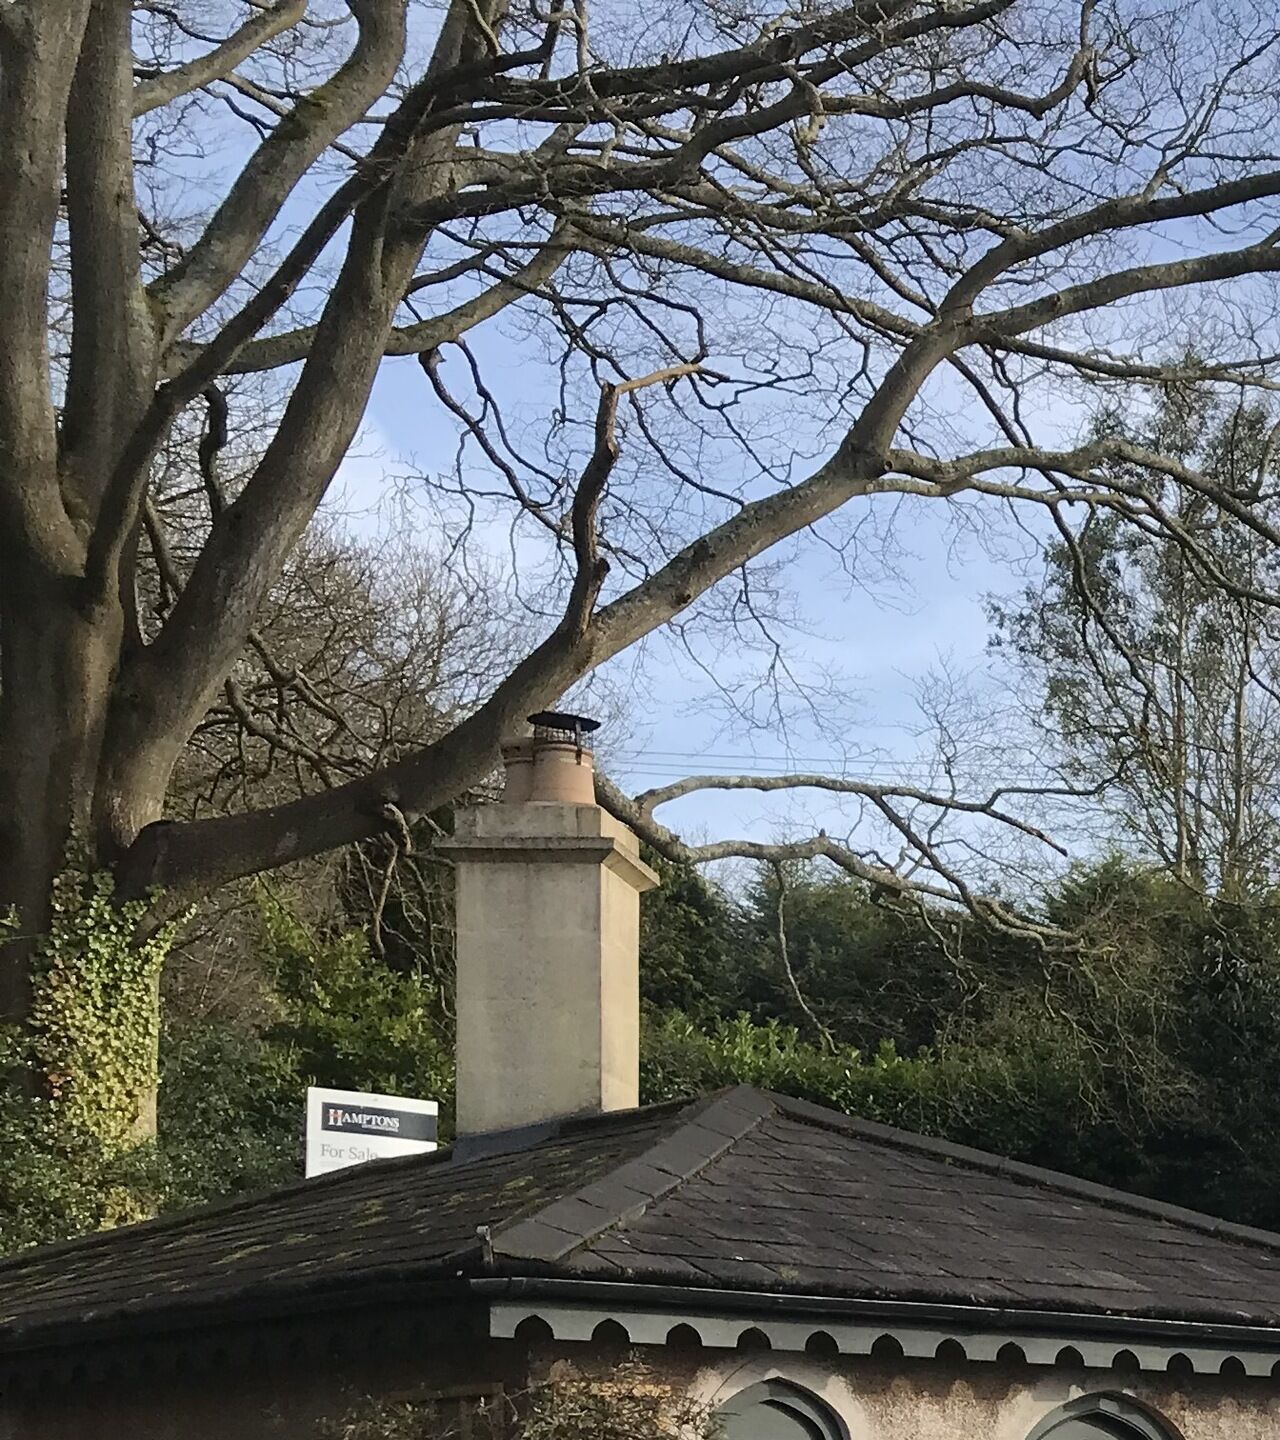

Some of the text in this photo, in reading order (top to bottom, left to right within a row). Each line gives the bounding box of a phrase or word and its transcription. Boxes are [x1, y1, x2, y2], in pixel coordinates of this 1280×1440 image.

[328, 1108, 400, 1128] HAMPTONS
[321, 1143, 378, 1161] For Sale
